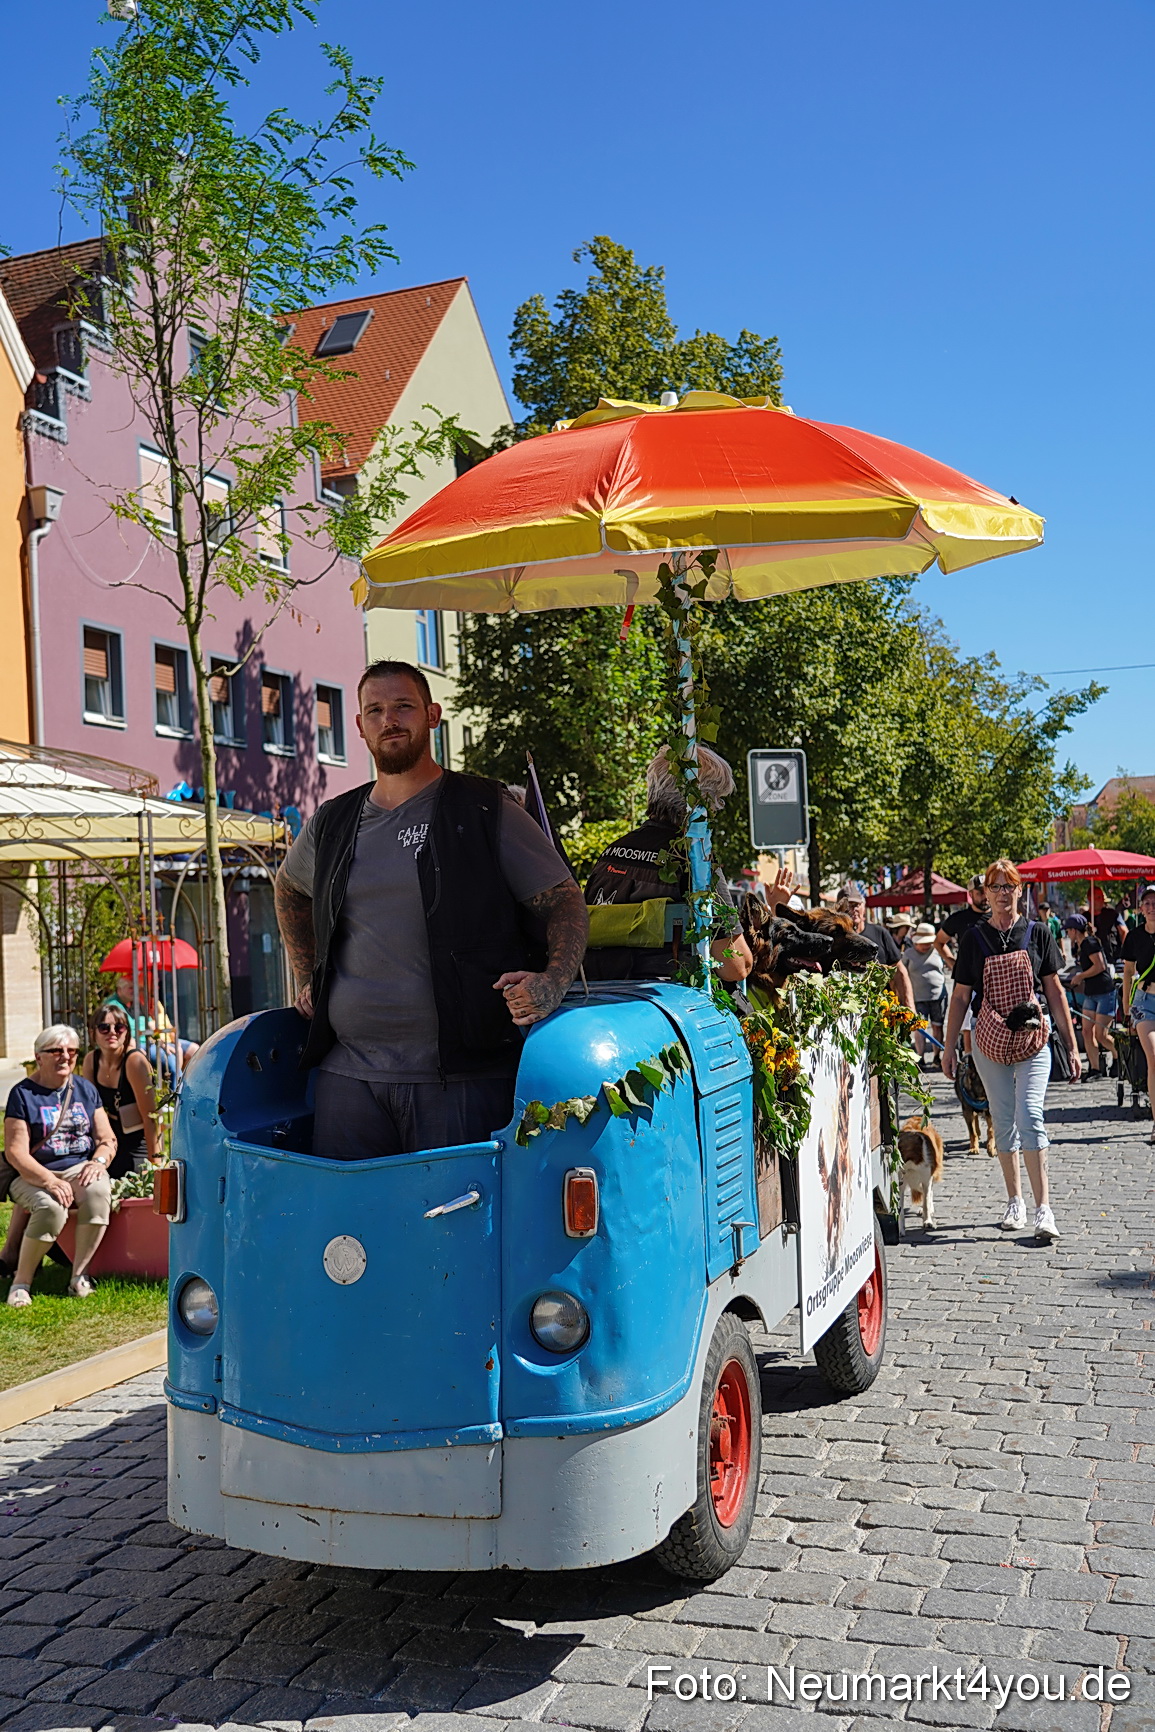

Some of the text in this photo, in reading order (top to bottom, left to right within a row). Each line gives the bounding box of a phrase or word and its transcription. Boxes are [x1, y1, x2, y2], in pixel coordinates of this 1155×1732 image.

[1047, 867, 1100, 879] Stadtrundfahrt
[1109, 866, 1154, 875] Stadtrundfahrt
[806, 1265, 844, 1317] Ortsgruppe
[844, 1231, 873, 1277] Mooswiese
